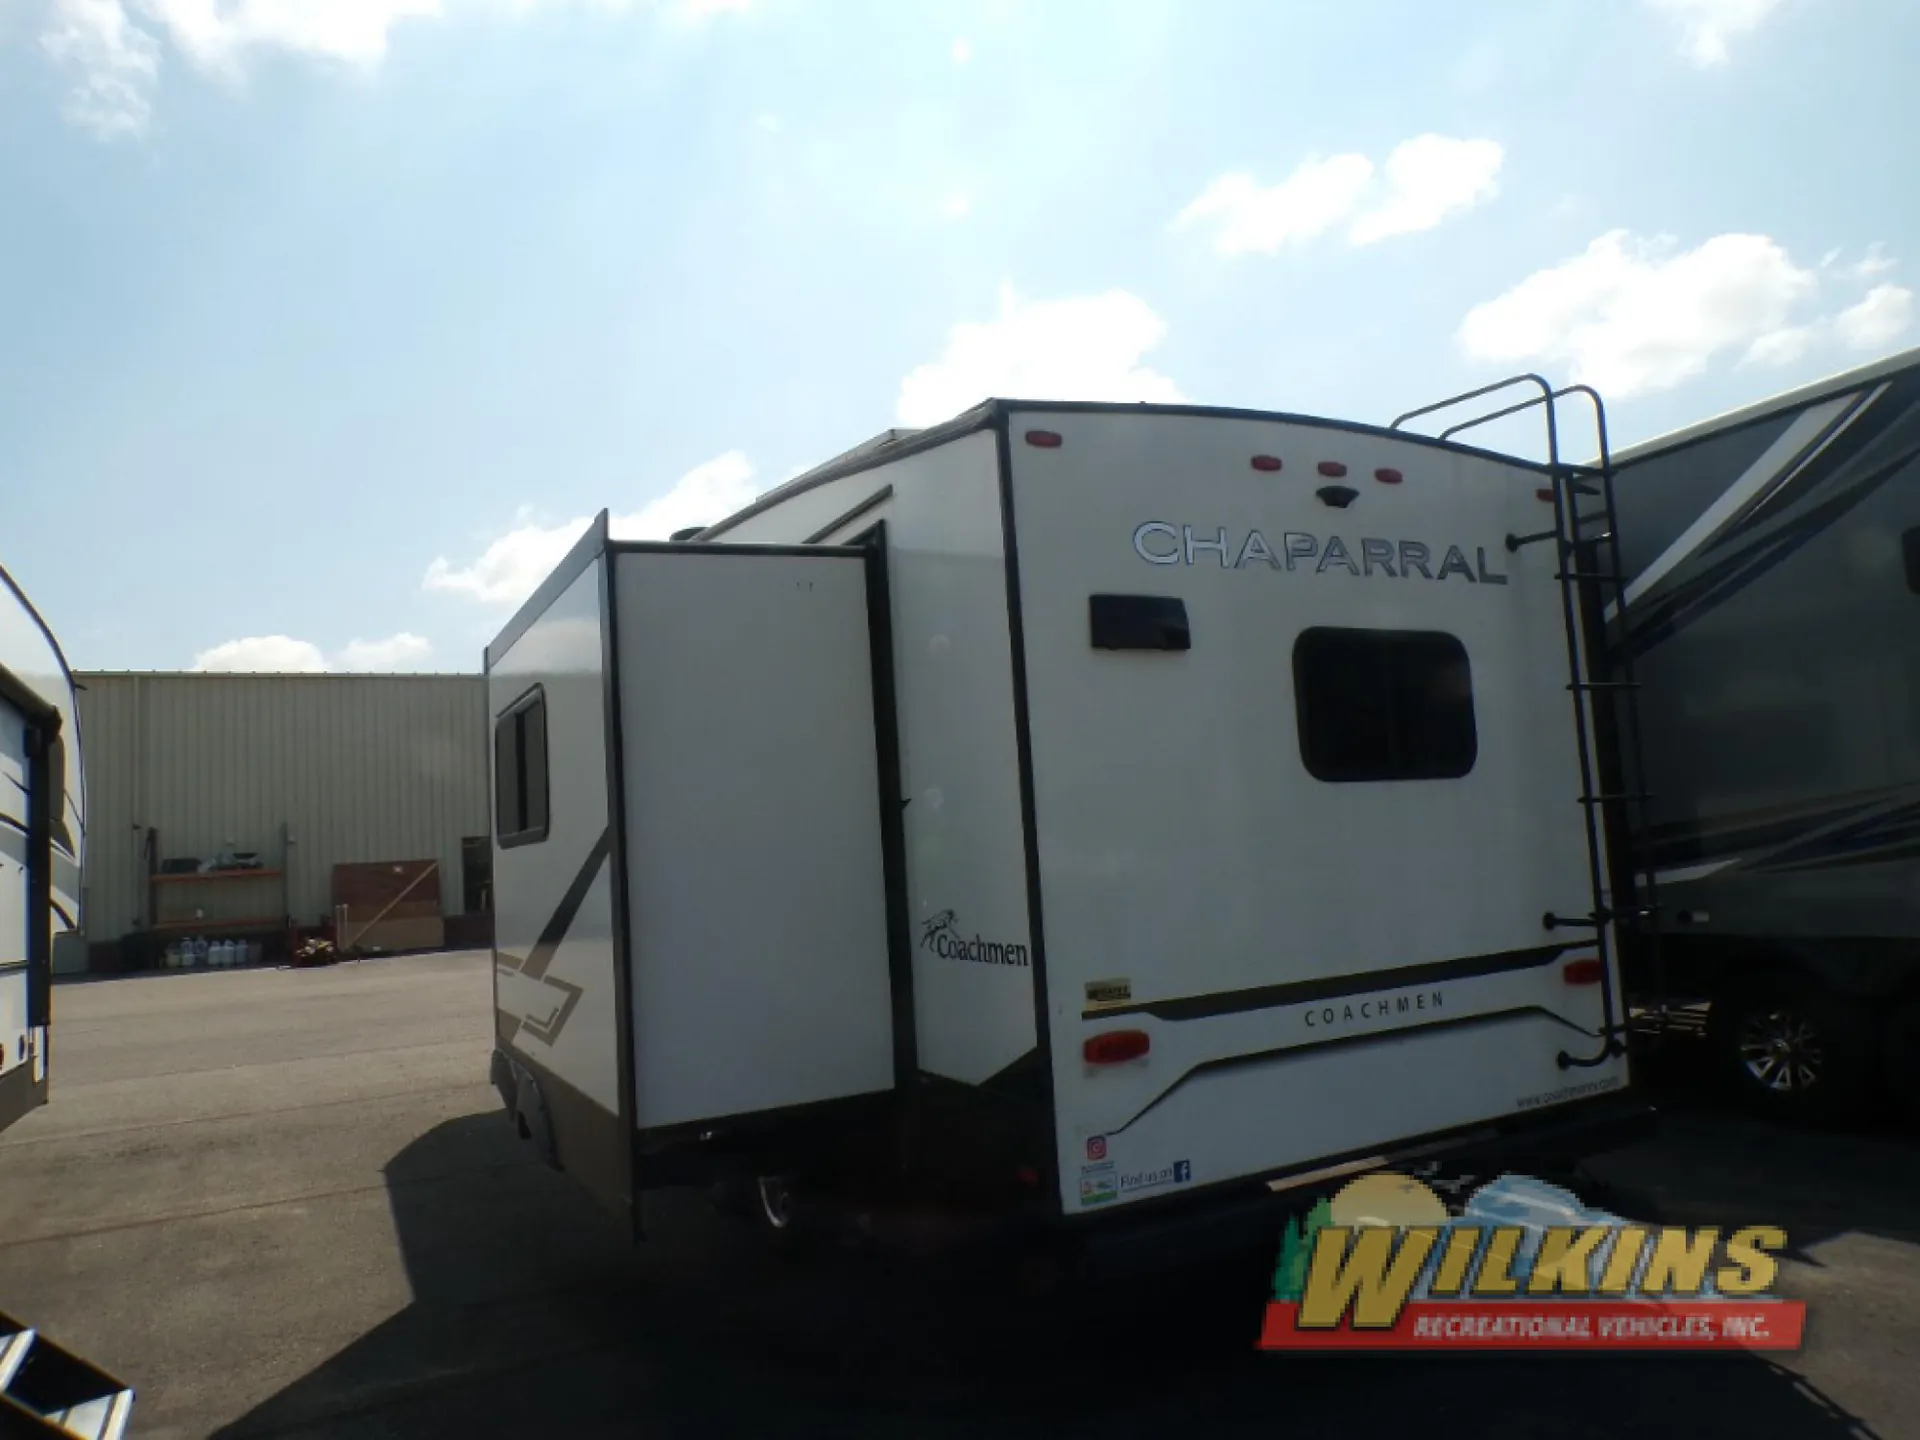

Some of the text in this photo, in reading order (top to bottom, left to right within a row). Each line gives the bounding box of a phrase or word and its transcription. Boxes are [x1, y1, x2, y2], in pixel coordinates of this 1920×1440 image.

[1132, 520, 1508, 585] CHAPARRAL
[937, 933, 1029, 967] Coachmen
[1304, 990, 1443, 1027] COACHMEN
